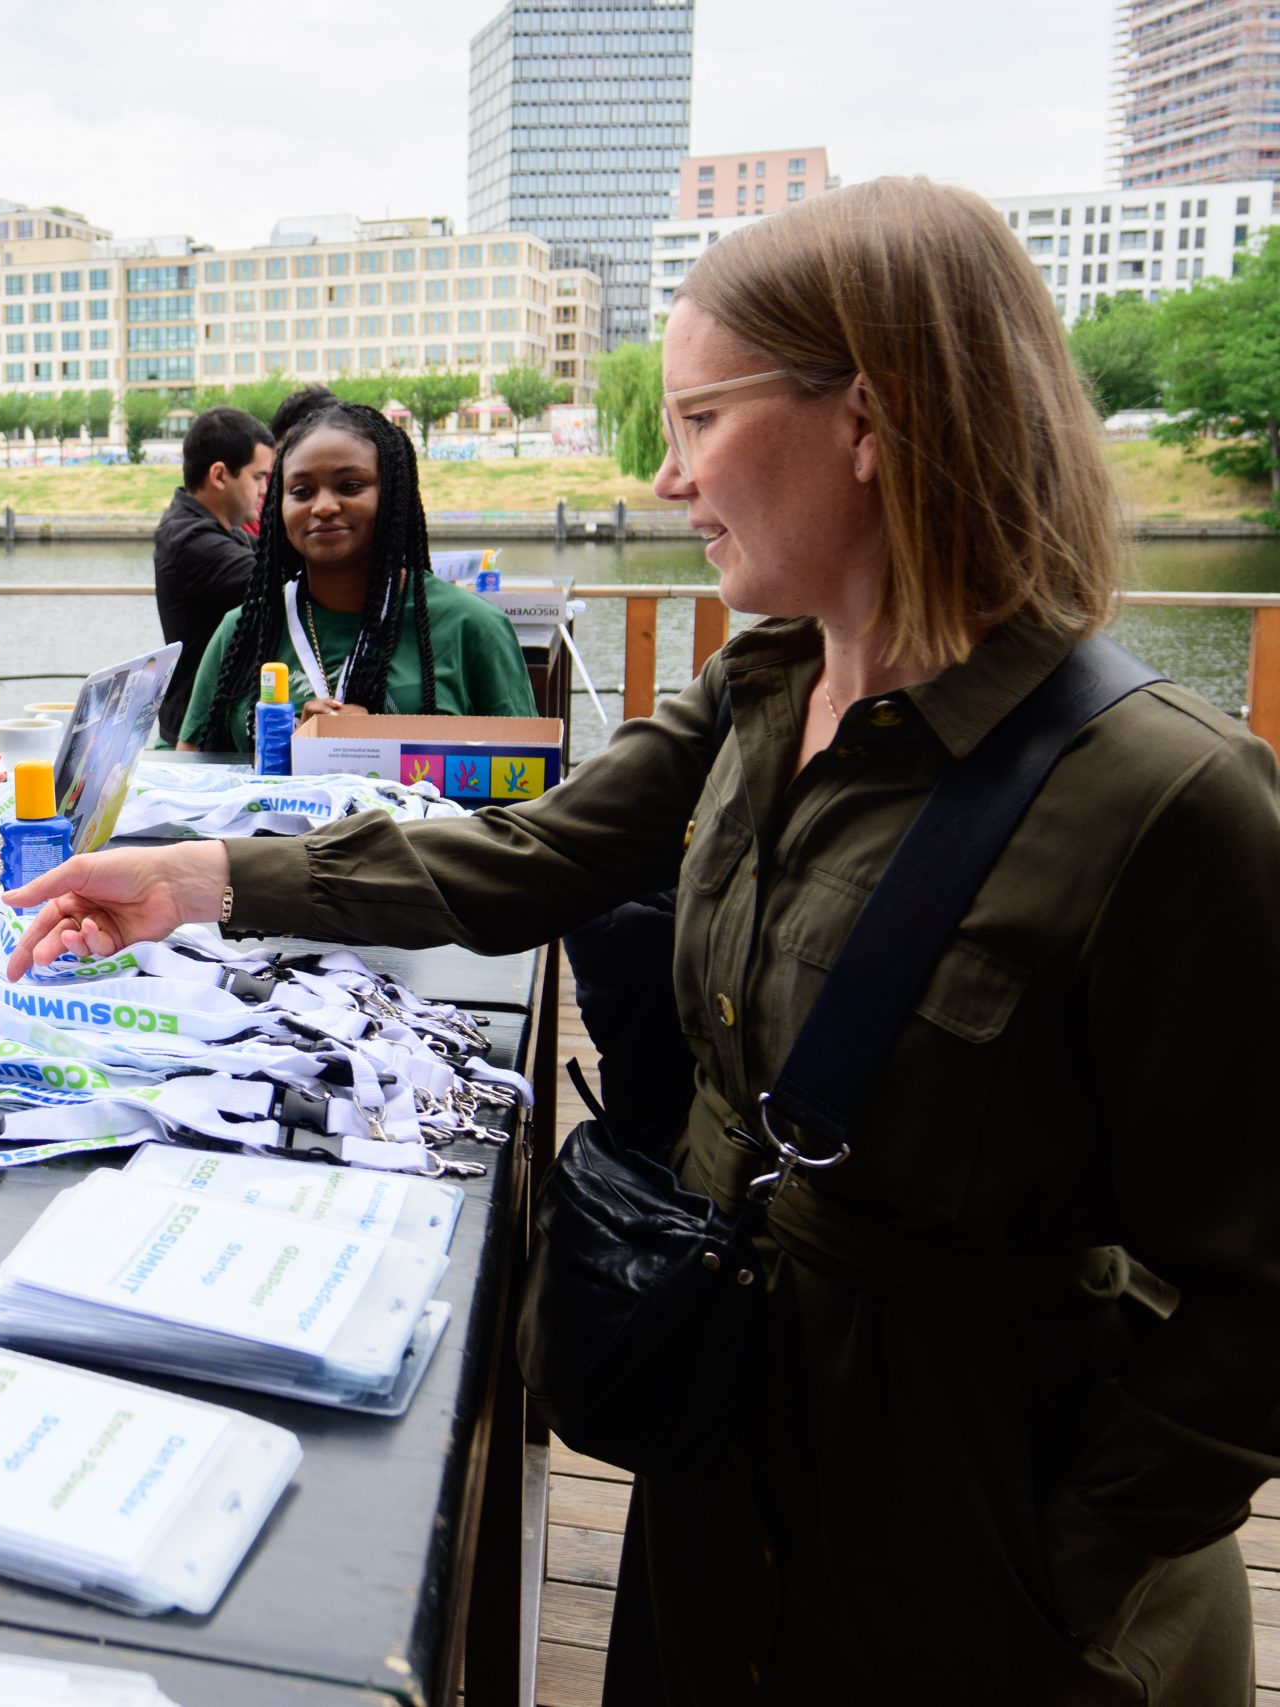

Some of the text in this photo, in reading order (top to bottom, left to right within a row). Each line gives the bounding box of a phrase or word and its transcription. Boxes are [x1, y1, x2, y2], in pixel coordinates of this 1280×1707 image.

[504, 607, 559, 617] DISCOVERY
[246, 796, 331, 818] OSUMMIT
[190, 1158, 220, 1190] ECOSU
[120, 1204, 201, 1296] ECOSUMMIT
[201, 1242, 243, 1286] Startup
[332, 1244, 359, 1272] Rod
[2, 1413, 61, 1473] Startup
[154, 1434, 187, 1469] Dan
